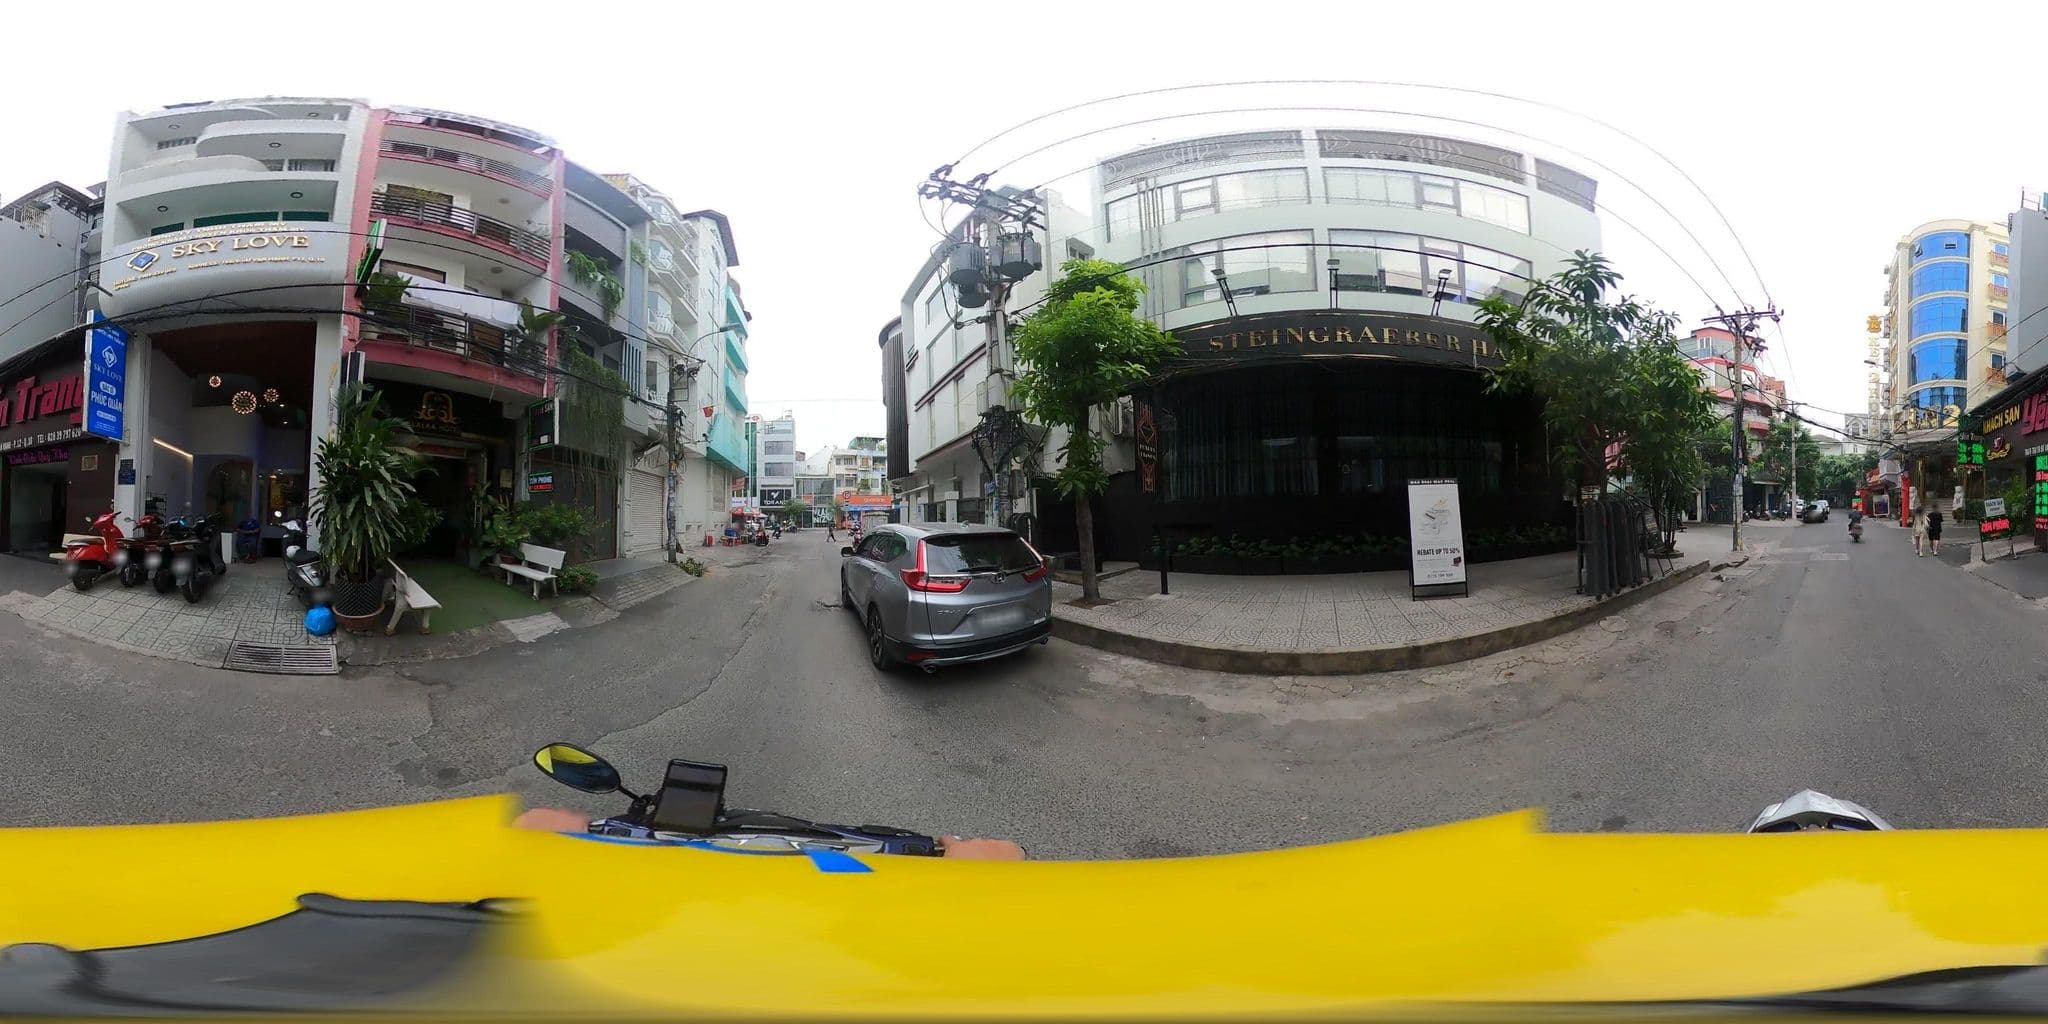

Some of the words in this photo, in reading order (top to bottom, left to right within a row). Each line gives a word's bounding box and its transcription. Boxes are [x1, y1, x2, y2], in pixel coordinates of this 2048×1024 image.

[172, 240, 223, 258] SKY
[233, 234, 309, 251] LOVE
[1208, 325, 1462, 353] STEINGRAEBER
